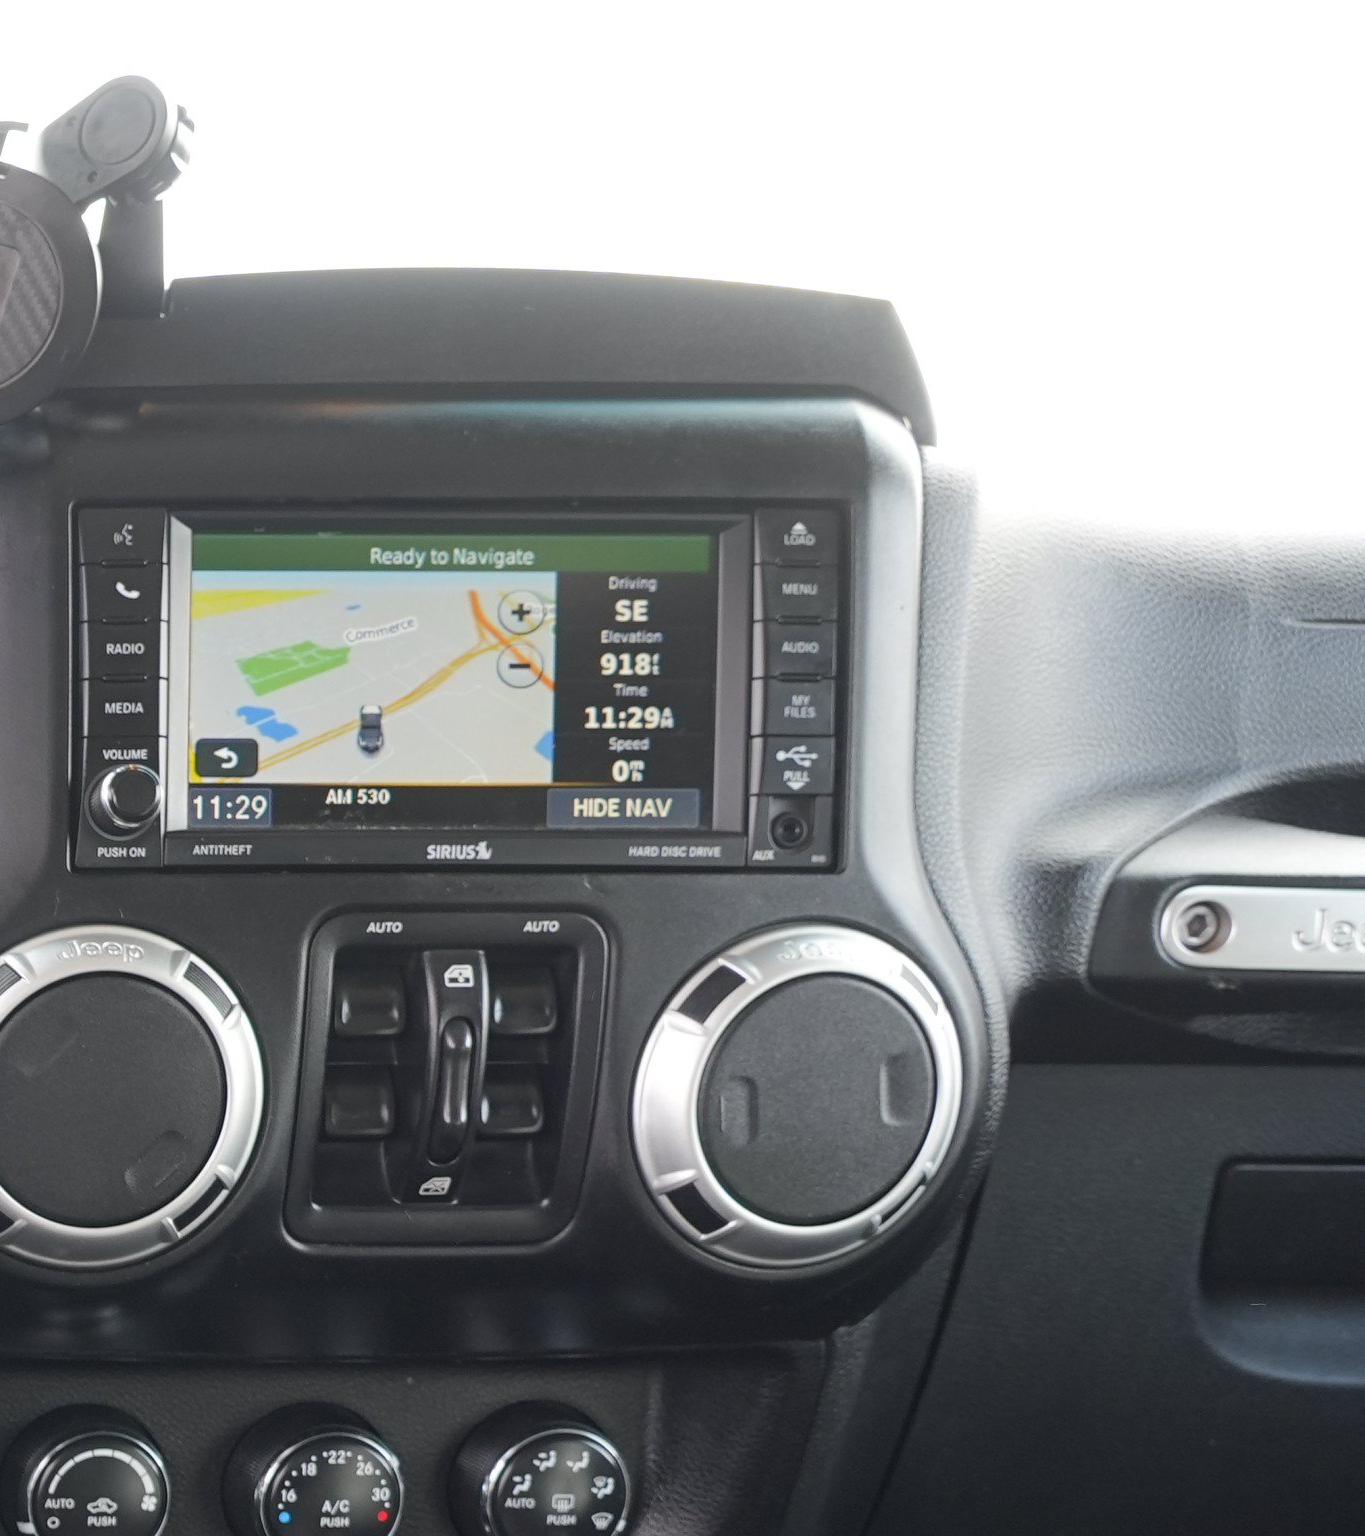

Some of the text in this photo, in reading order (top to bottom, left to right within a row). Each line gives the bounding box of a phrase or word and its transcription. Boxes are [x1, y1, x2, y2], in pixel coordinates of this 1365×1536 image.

[784, 534, 816, 546] LOAD
[370, 547, 536, 569] Ready to Navigate
[608, 576, 658, 592] Driving
[781, 583, 819, 596] MENU
[614, 599, 649, 622] SE
[346, 618, 416, 643] Commerce
[600, 629, 664, 644] Elevation
[106, 643, 145, 655] RADIO
[781, 641, 820, 654] AUDIO
[612, 682, 649, 697] Time
[104, 701, 144, 714] MEDIA
[791, 695, 811, 706] MY
[783, 706, 817, 719] FILES
[608, 737, 650, 752] Speed
[102, 749, 148, 761] VOLUME
[783, 770, 810, 783] PULL
[325, 788, 391, 804] AM 530
[193, 795, 268, 820] 11:29
[573, 797, 673, 818] HIDE NAV
[97, 847, 146, 859] PUSH ON
[192, 844, 253, 856] ANTITHEFT
[426, 844, 476, 860] SIRIUS
[628, 846, 722, 858] HARD DISC DRIVE
[752, 850, 775, 861] AUX
[366, 921, 404, 934] AUTO
[523, 920, 560, 934] AUTO
[1291, 908, 1365, 953] Je
[56, 939, 145, 963] Jeep
[327, 1450, 347, 1464] 22
[300, 1462, 317, 1477] 18
[356, 1461, 374, 1476] 26
[281, 1488, 298, 1503] 16
[371, 1487, 390, 1502] 30
[44, 1498, 76, 1510] AUTO
[321, 1499, 350, 1515] A/C
[504, 1497, 536, 1509] AUTO
[87, 1515, 117, 1527] PUSH
[320, 1516, 350, 1528] PUSH
[546, 1514, 577, 1526] PUSH
